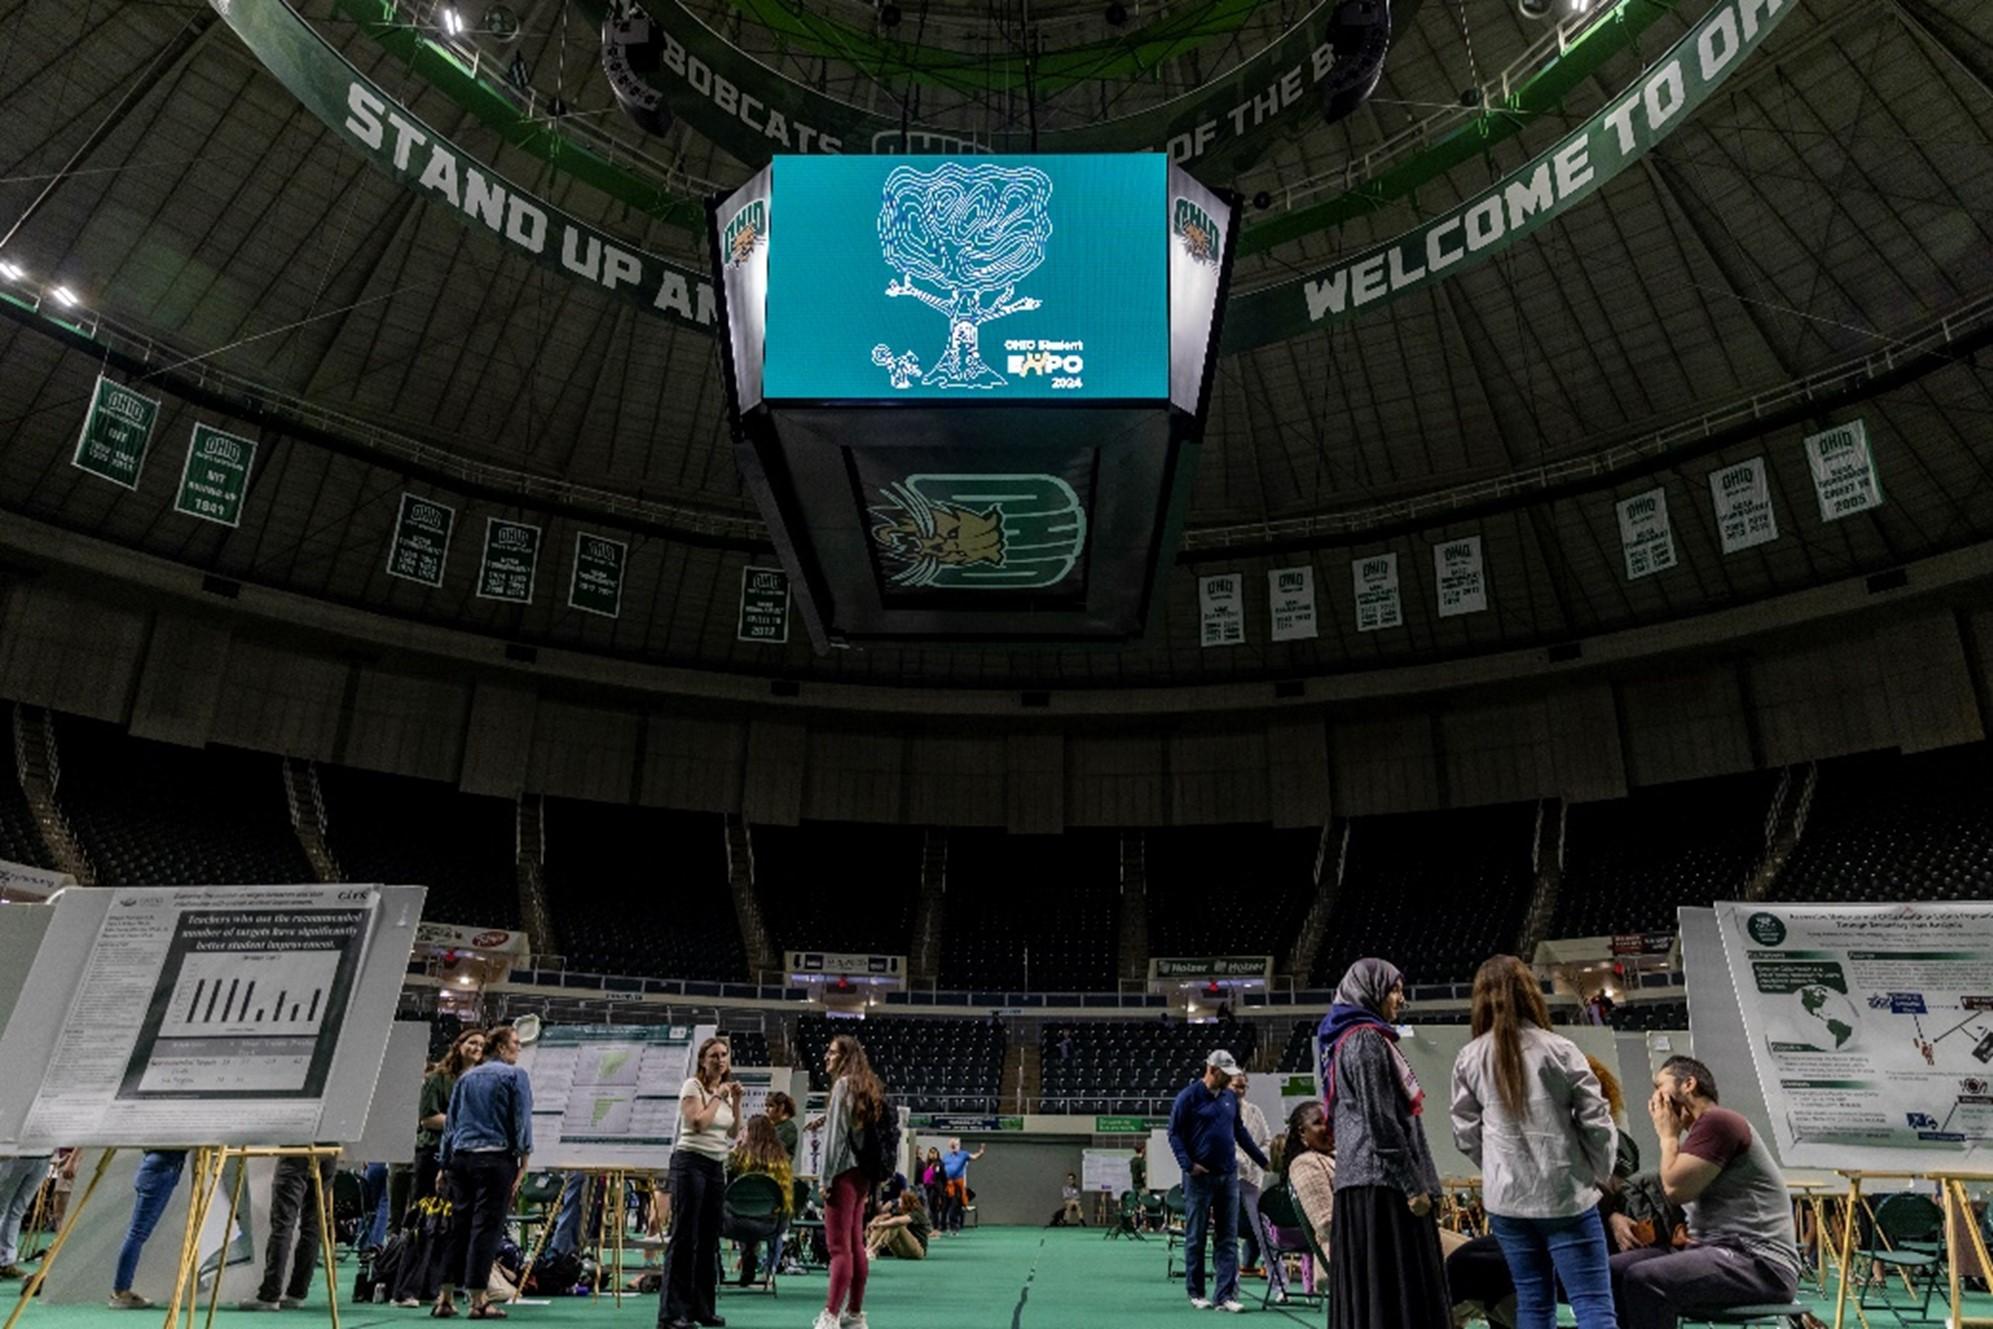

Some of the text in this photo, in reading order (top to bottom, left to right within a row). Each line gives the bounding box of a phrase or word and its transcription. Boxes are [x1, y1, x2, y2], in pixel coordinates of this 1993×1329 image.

[1166, 119, 1218, 165] OF
[1227, 64, 1303, 136] THE
[345, 82, 548, 254] STAND
[562, 224, 643, 290] UP
[1303, 133, 1594, 322] WELCOME
[1604, 59, 1685, 156] TO
[1007, 352, 1083, 377] EXPO
[1834, 493, 1867, 512] 2005
[232, 914, 253, 923] who
[274, 913, 290, 923] the
[223, 927, 237, 938] of
[237, 927, 270, 938] targets
[298, 927, 358, 938] significantly
[196, 940, 225, 950] better
[227, 940, 265, 950] student
